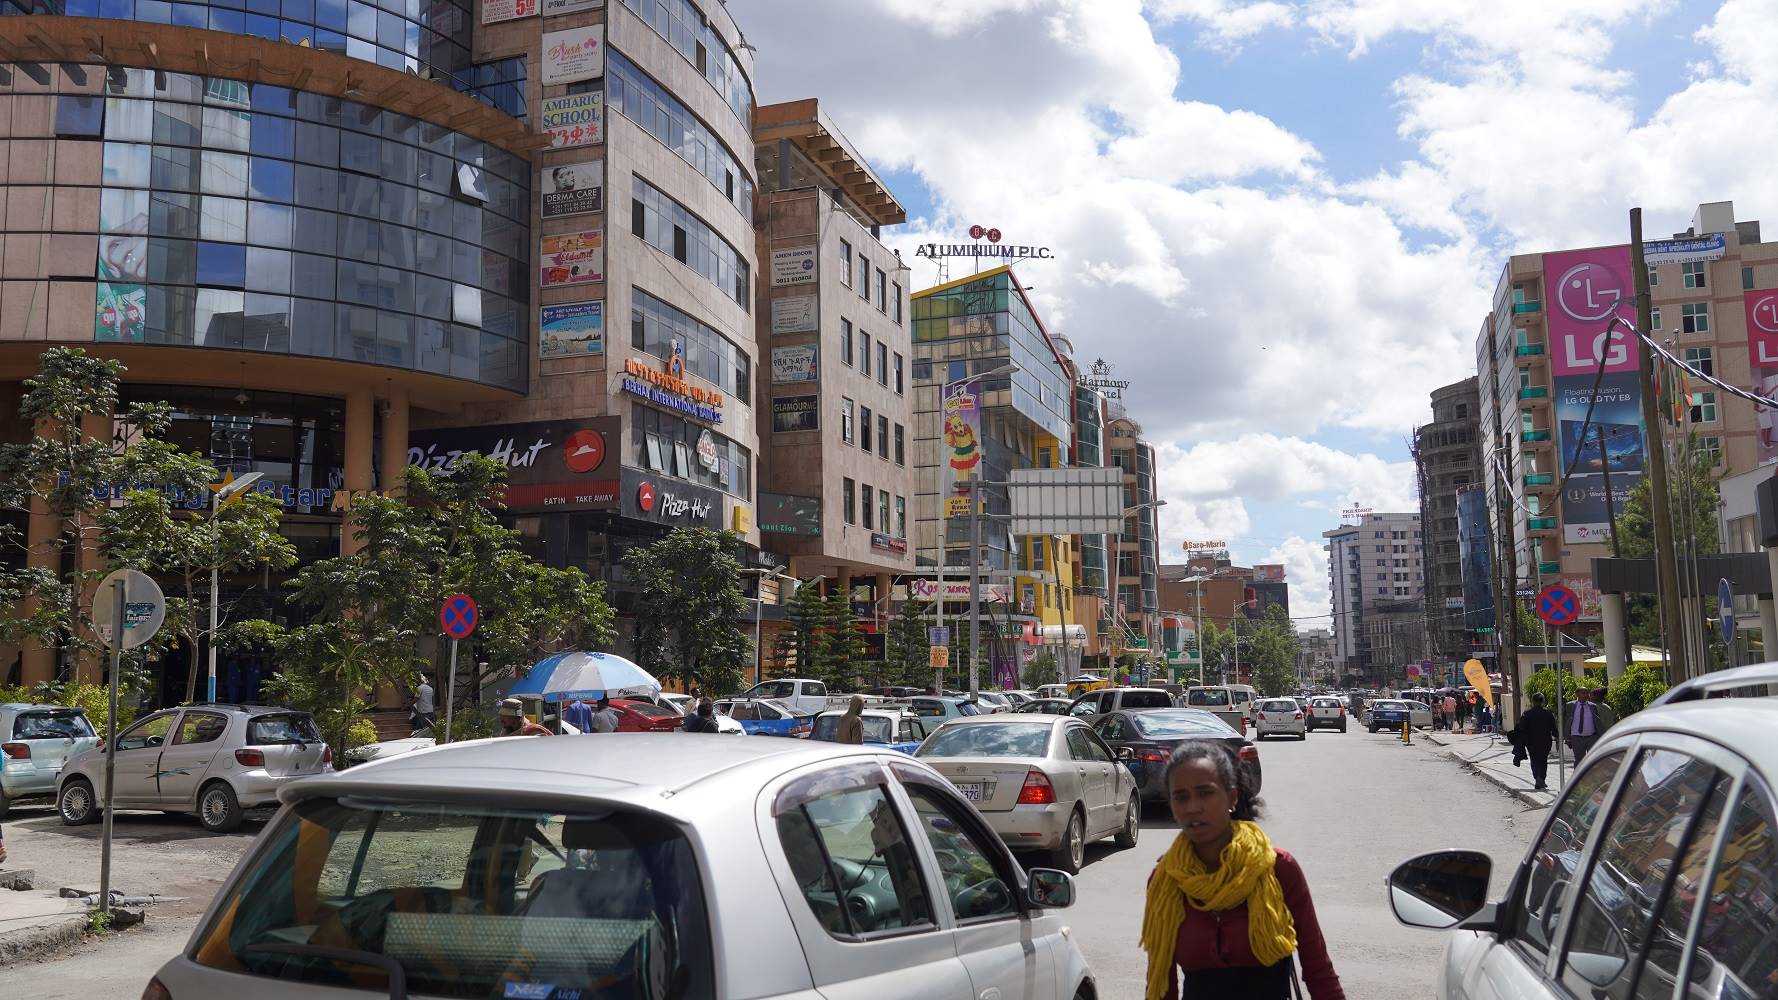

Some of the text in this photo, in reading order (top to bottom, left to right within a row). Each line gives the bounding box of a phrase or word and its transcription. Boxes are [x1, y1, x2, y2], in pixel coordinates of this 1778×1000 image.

[544, 94, 600, 112] AMHARIC
[544, 108, 600, 128] SCHOOL
[546, 193, 574, 202] DERMA
[576, 188, 597, 199] CARE
[1018, 246, 1055, 259] PLC.
[1564, 331, 1628, 368] LG
[1080, 374, 1130, 390] Harmony
[652, 390, 698, 415] INTERNATIONAL
[1580, 396, 1602, 404] OLD
[1619, 394, 1631, 402] E8
[661, 493, 713, 519] Pizza Hut
